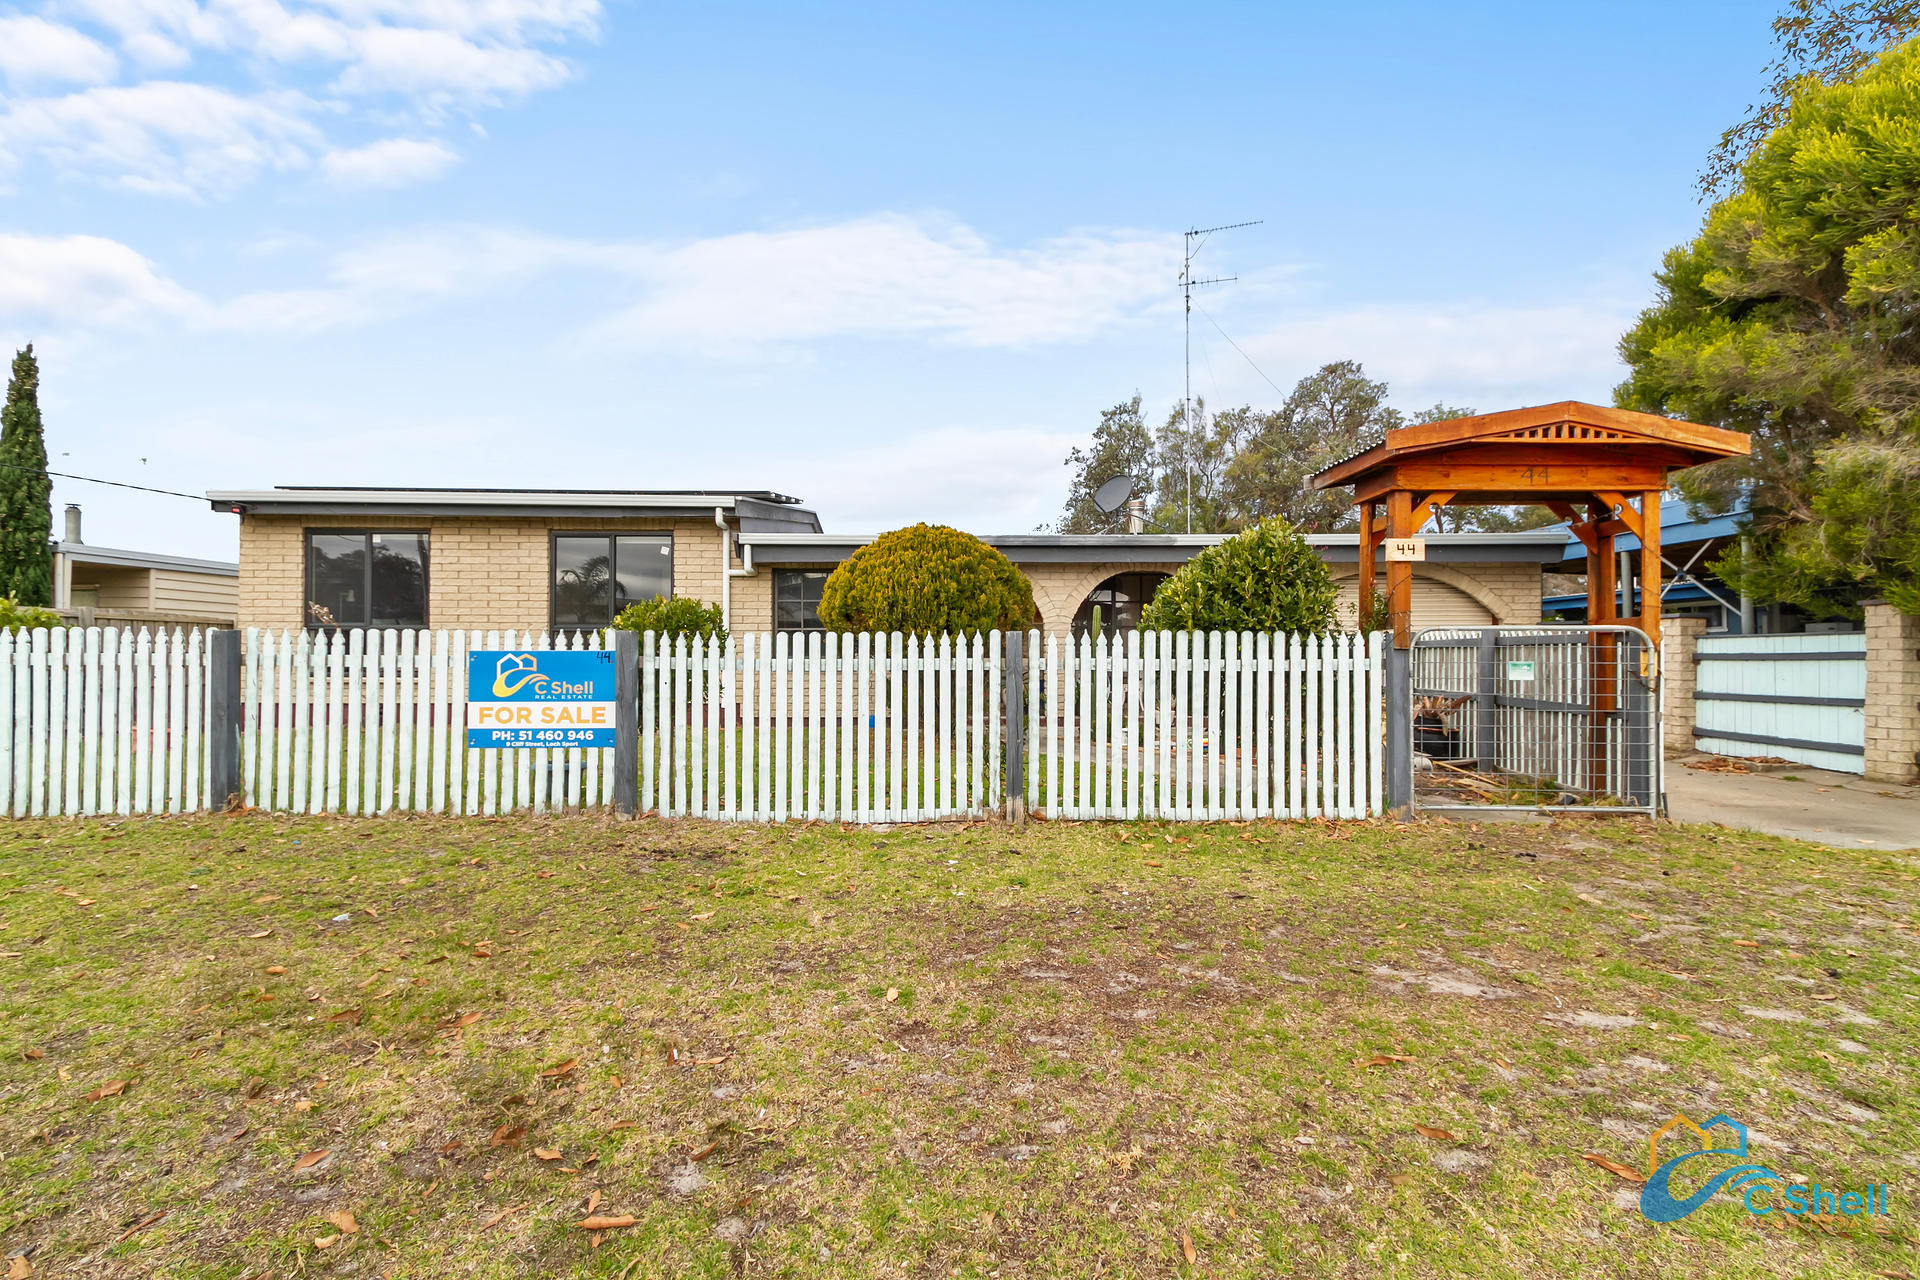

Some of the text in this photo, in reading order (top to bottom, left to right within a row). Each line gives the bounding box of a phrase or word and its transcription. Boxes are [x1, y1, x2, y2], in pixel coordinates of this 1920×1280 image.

[1397, 543, 1415, 555] 44
[597, 651, 612, 664] 44
[534, 680, 593, 694] C Shell
[479, 706, 606, 724] FOR SALE
[492, 730, 594, 741] PH: 51 460 946
